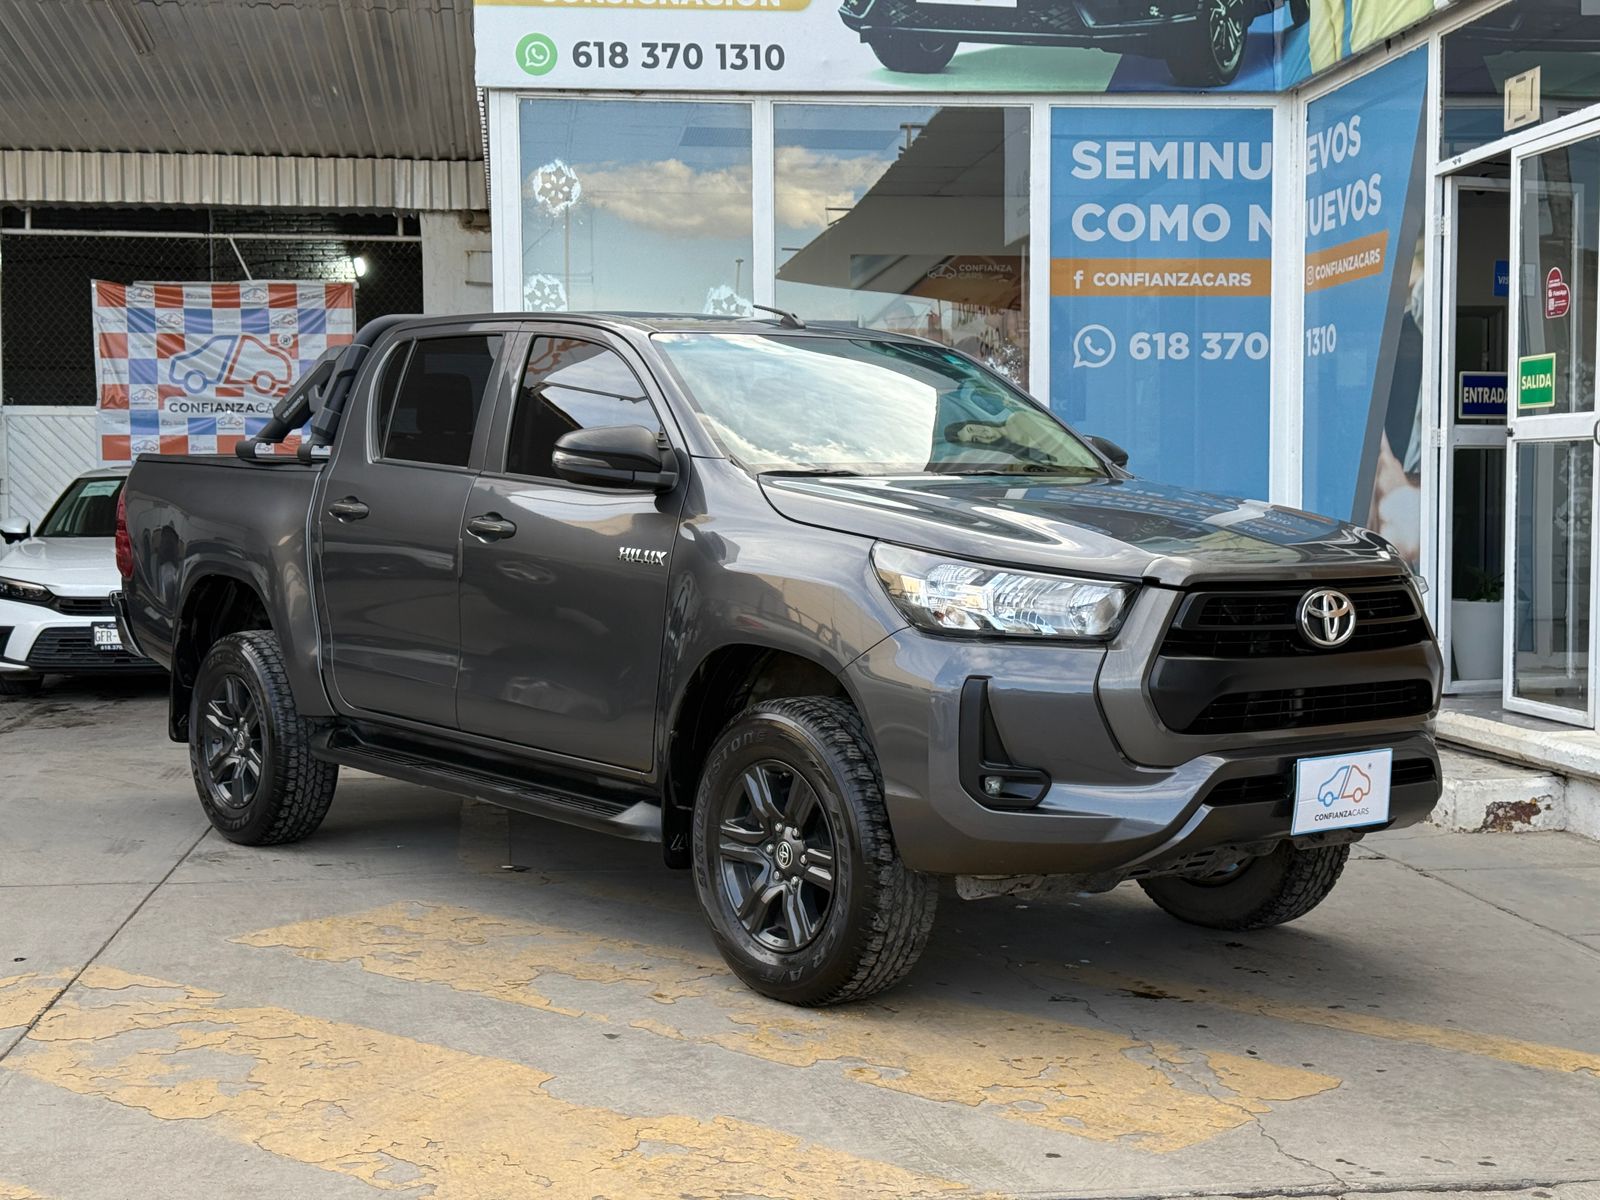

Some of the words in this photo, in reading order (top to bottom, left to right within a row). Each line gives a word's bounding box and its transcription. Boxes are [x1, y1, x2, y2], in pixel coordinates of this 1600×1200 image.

[571, 41, 629, 69] 618
[640, 42, 703, 70] 370
[715, 43, 785, 70] 1310
[1070, 140, 1272, 180] SEMINU
[1306, 172, 1381, 238] UEVOS
[1071, 202, 1231, 242] COMO
[958, 264, 1013, 273] CONFIANZA
[1314, 248, 1381, 280] CONFIANZACARS
[1093, 272, 1252, 287] CONFIANZACARS
[1129, 331, 1190, 360] 618
[1200, 331, 1270, 360] 370
[1305, 323, 1337, 357] 1310
[1521, 373, 1552, 390] SALIDA
[617, 546, 667, 566] HILUX
[1314, 808, 1370, 821] CONFIANZACARS
